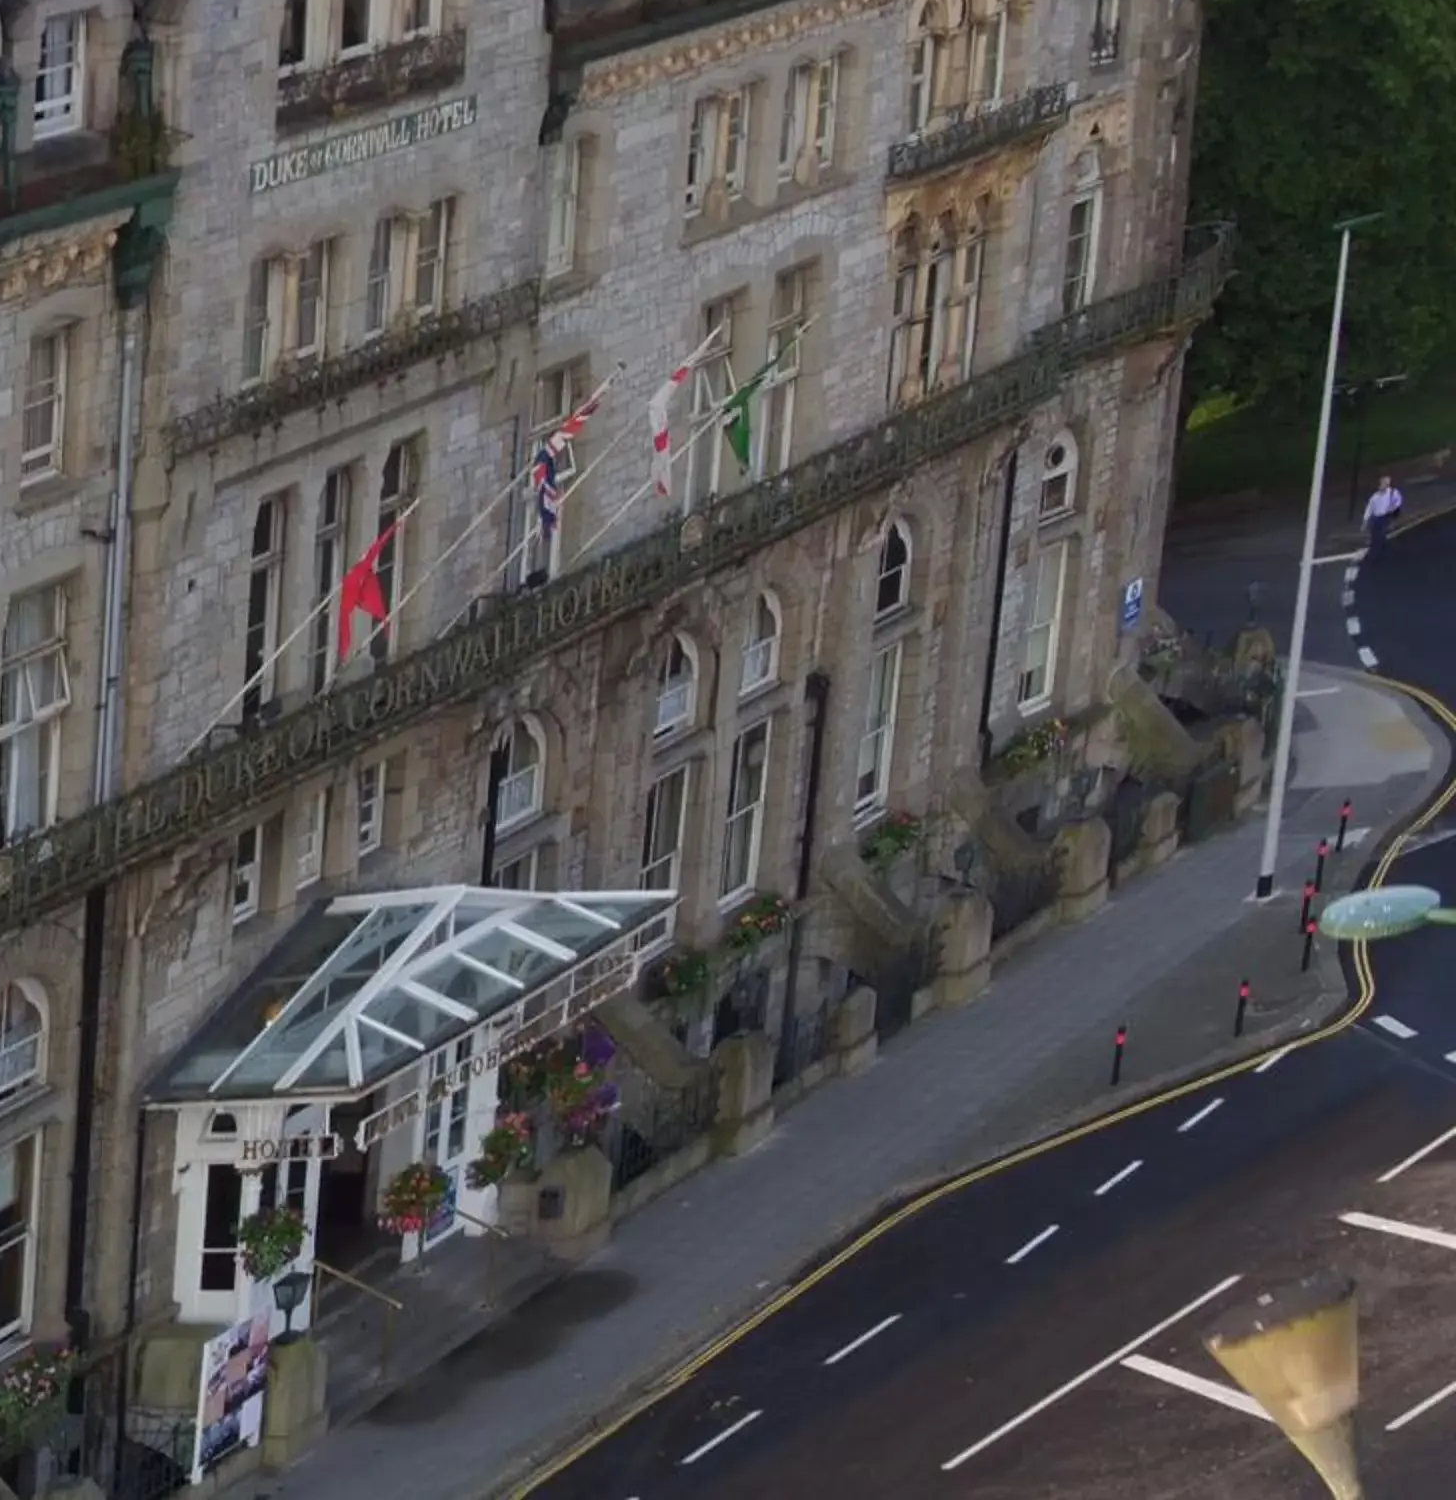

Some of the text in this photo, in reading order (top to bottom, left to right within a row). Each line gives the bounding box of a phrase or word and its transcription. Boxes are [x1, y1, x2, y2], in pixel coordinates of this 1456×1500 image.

[253, 146, 309, 192] DUKE
[325, 117, 412, 168] CORNWALL
[415, 98, 474, 140] HOTEL
